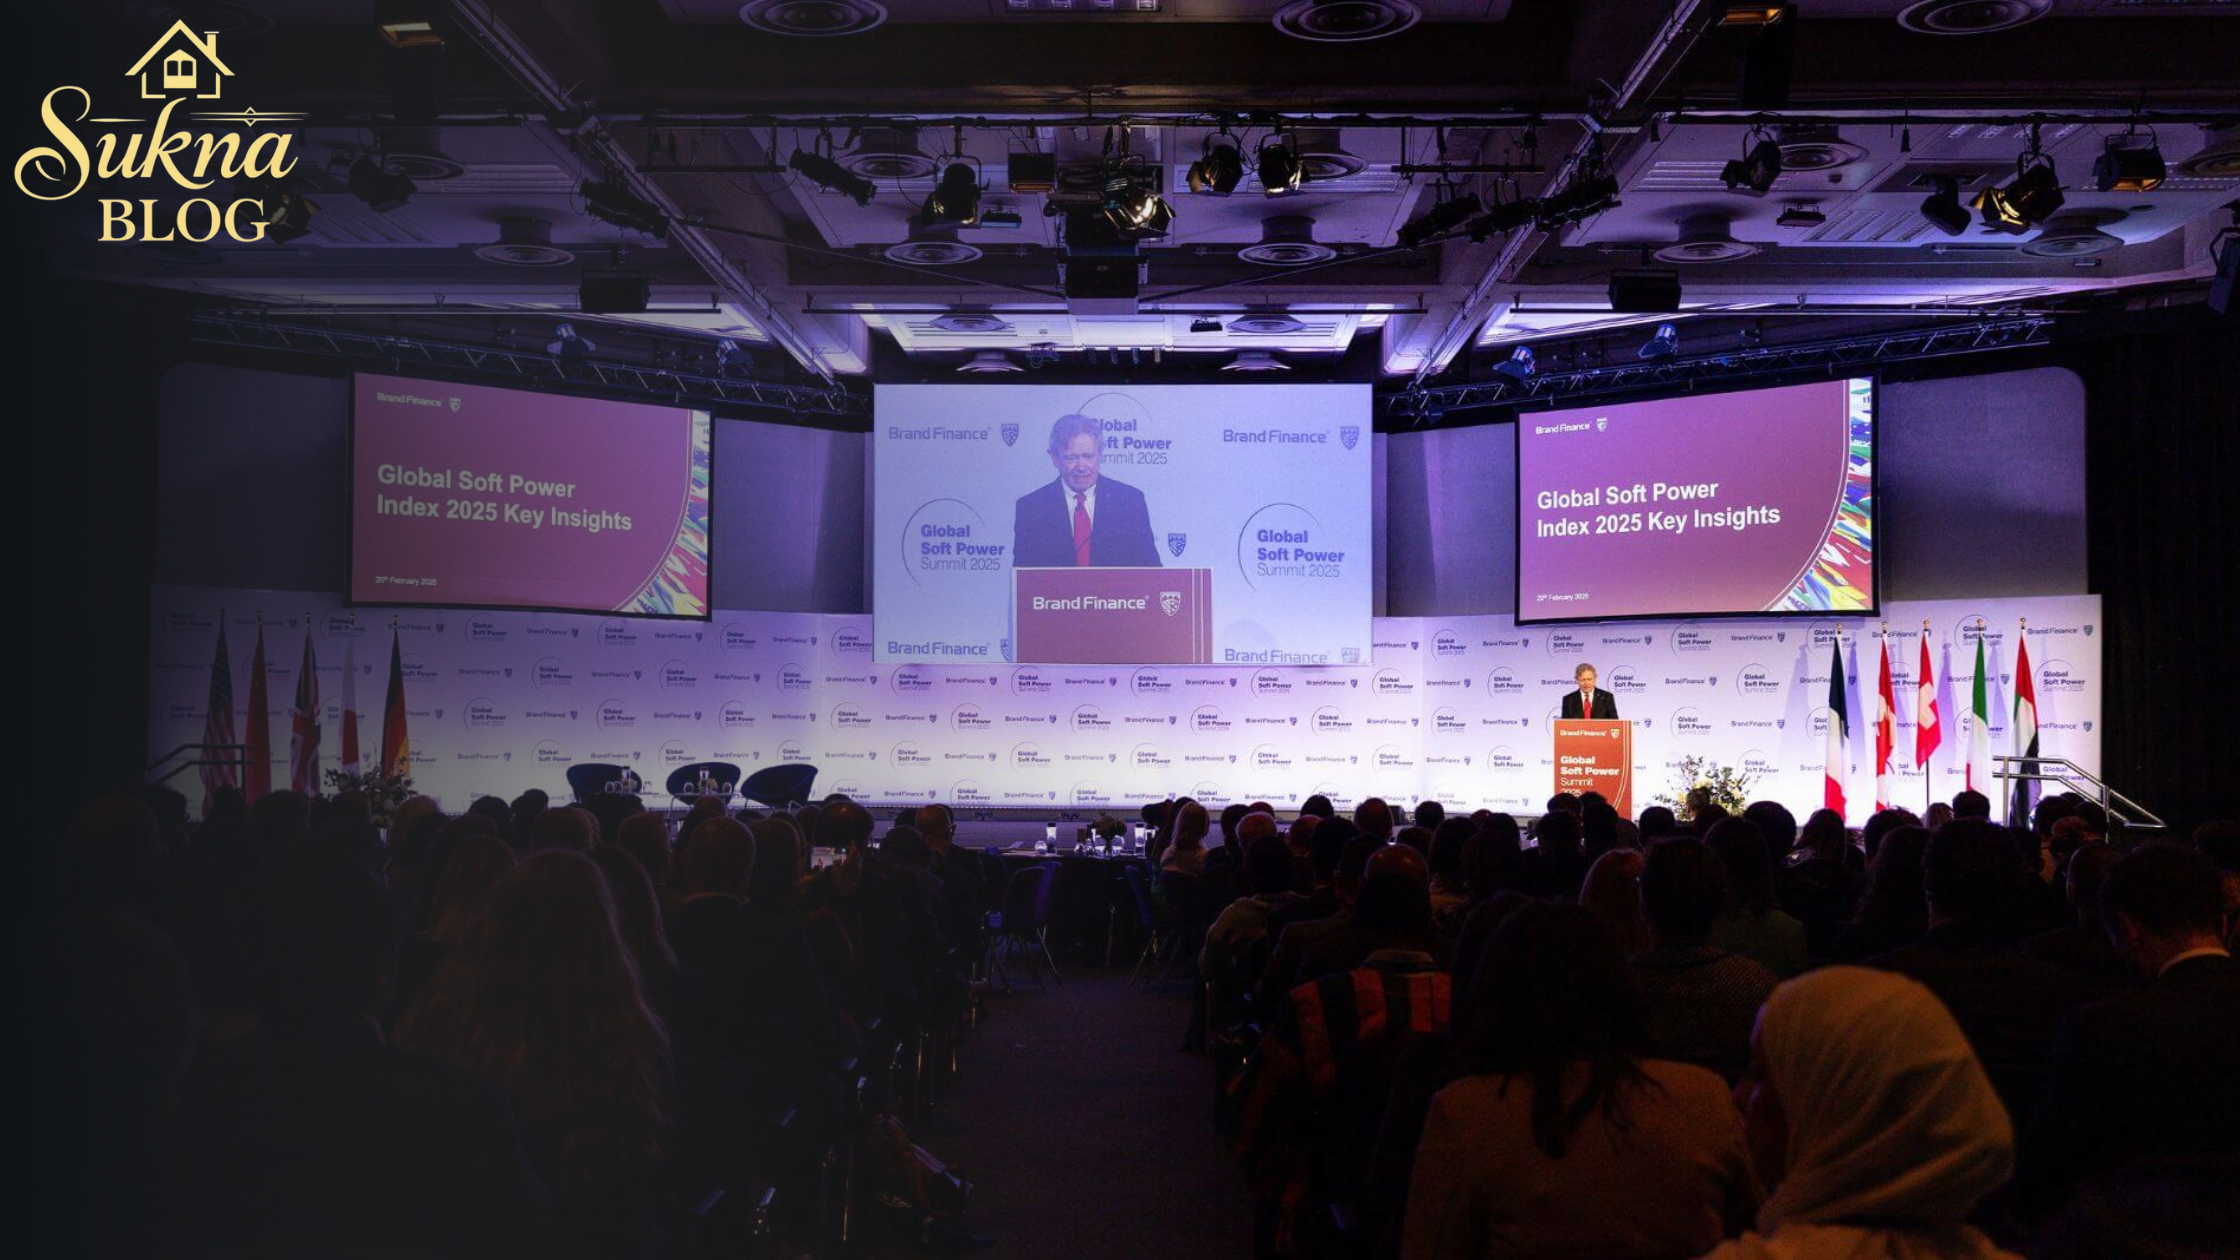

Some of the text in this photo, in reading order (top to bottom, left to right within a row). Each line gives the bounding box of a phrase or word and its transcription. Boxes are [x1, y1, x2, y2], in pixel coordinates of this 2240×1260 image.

[1094, 418, 1137, 431] lobal
[1123, 436, 1172, 450] Power
[1137, 452, 1168, 465] 2025
[377, 464, 576, 499] Global Soft Power
[1537, 480, 1718, 510] Global Soft Power
[377, 494, 632, 533] Index 2025 Key Insights
[1537, 504, 1781, 538] Index 2025 Key Insights
[920, 524, 970, 537] Global
[1257, 529, 1308, 543] Global
[920, 542, 1005, 556] Soft Power
[1257, 547, 1345, 562] Soft Power
[920, 556, 1000, 571] Summit 2025
[1257, 562, 1340, 577] Summit 2025
[390, 576, 420, 587] February
[420, 578, 437, 586] 2025
[1560, 755, 1595, 764] Global
[1560, 766, 1620, 776] Soft Power
[1560, 777, 1593, 786] Summit
